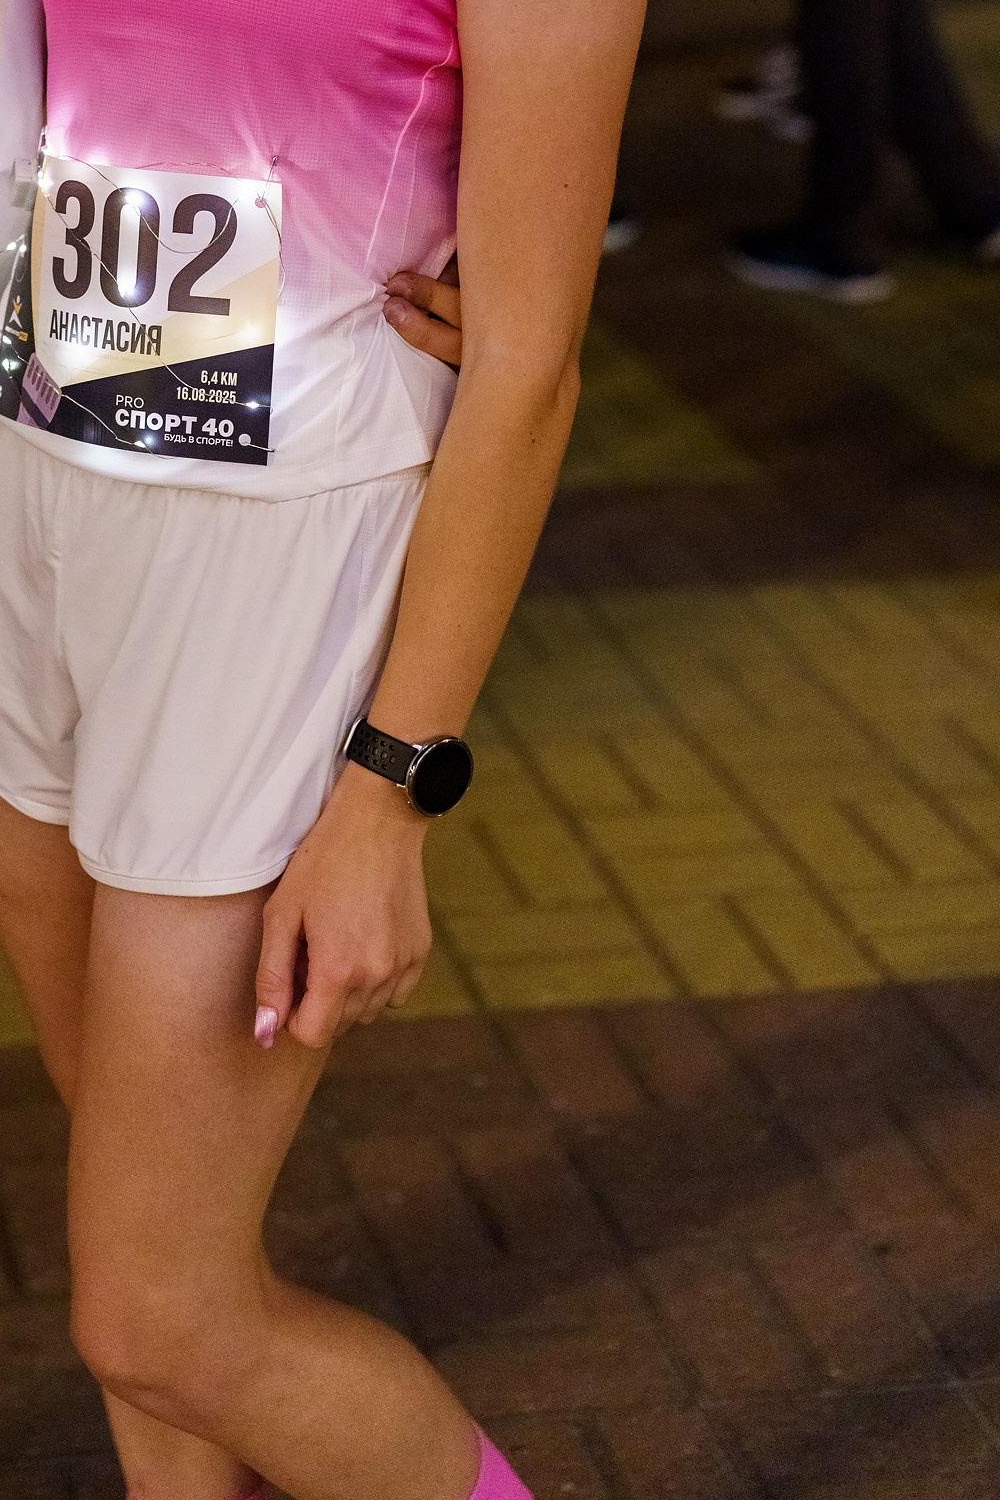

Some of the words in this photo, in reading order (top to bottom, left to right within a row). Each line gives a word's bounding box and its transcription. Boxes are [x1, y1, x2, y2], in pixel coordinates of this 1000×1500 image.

[52, 179, 238, 316] 302
[49, 308, 163, 357] АНАСТАСИЯ
[200, 370, 219, 386] 6,4
[220, 371, 238, 386] КМ
[115, 394, 145, 409] PRO
[176, 386, 237, 405] 16.08.2025
[115, 408, 198, 434] СПОРТ
[201, 418, 235, 438] 40
[163, 433, 187, 444] БУДЬ
[189, 435, 195, 444] В
[196, 436, 234, 447] СПОРТЕ!
